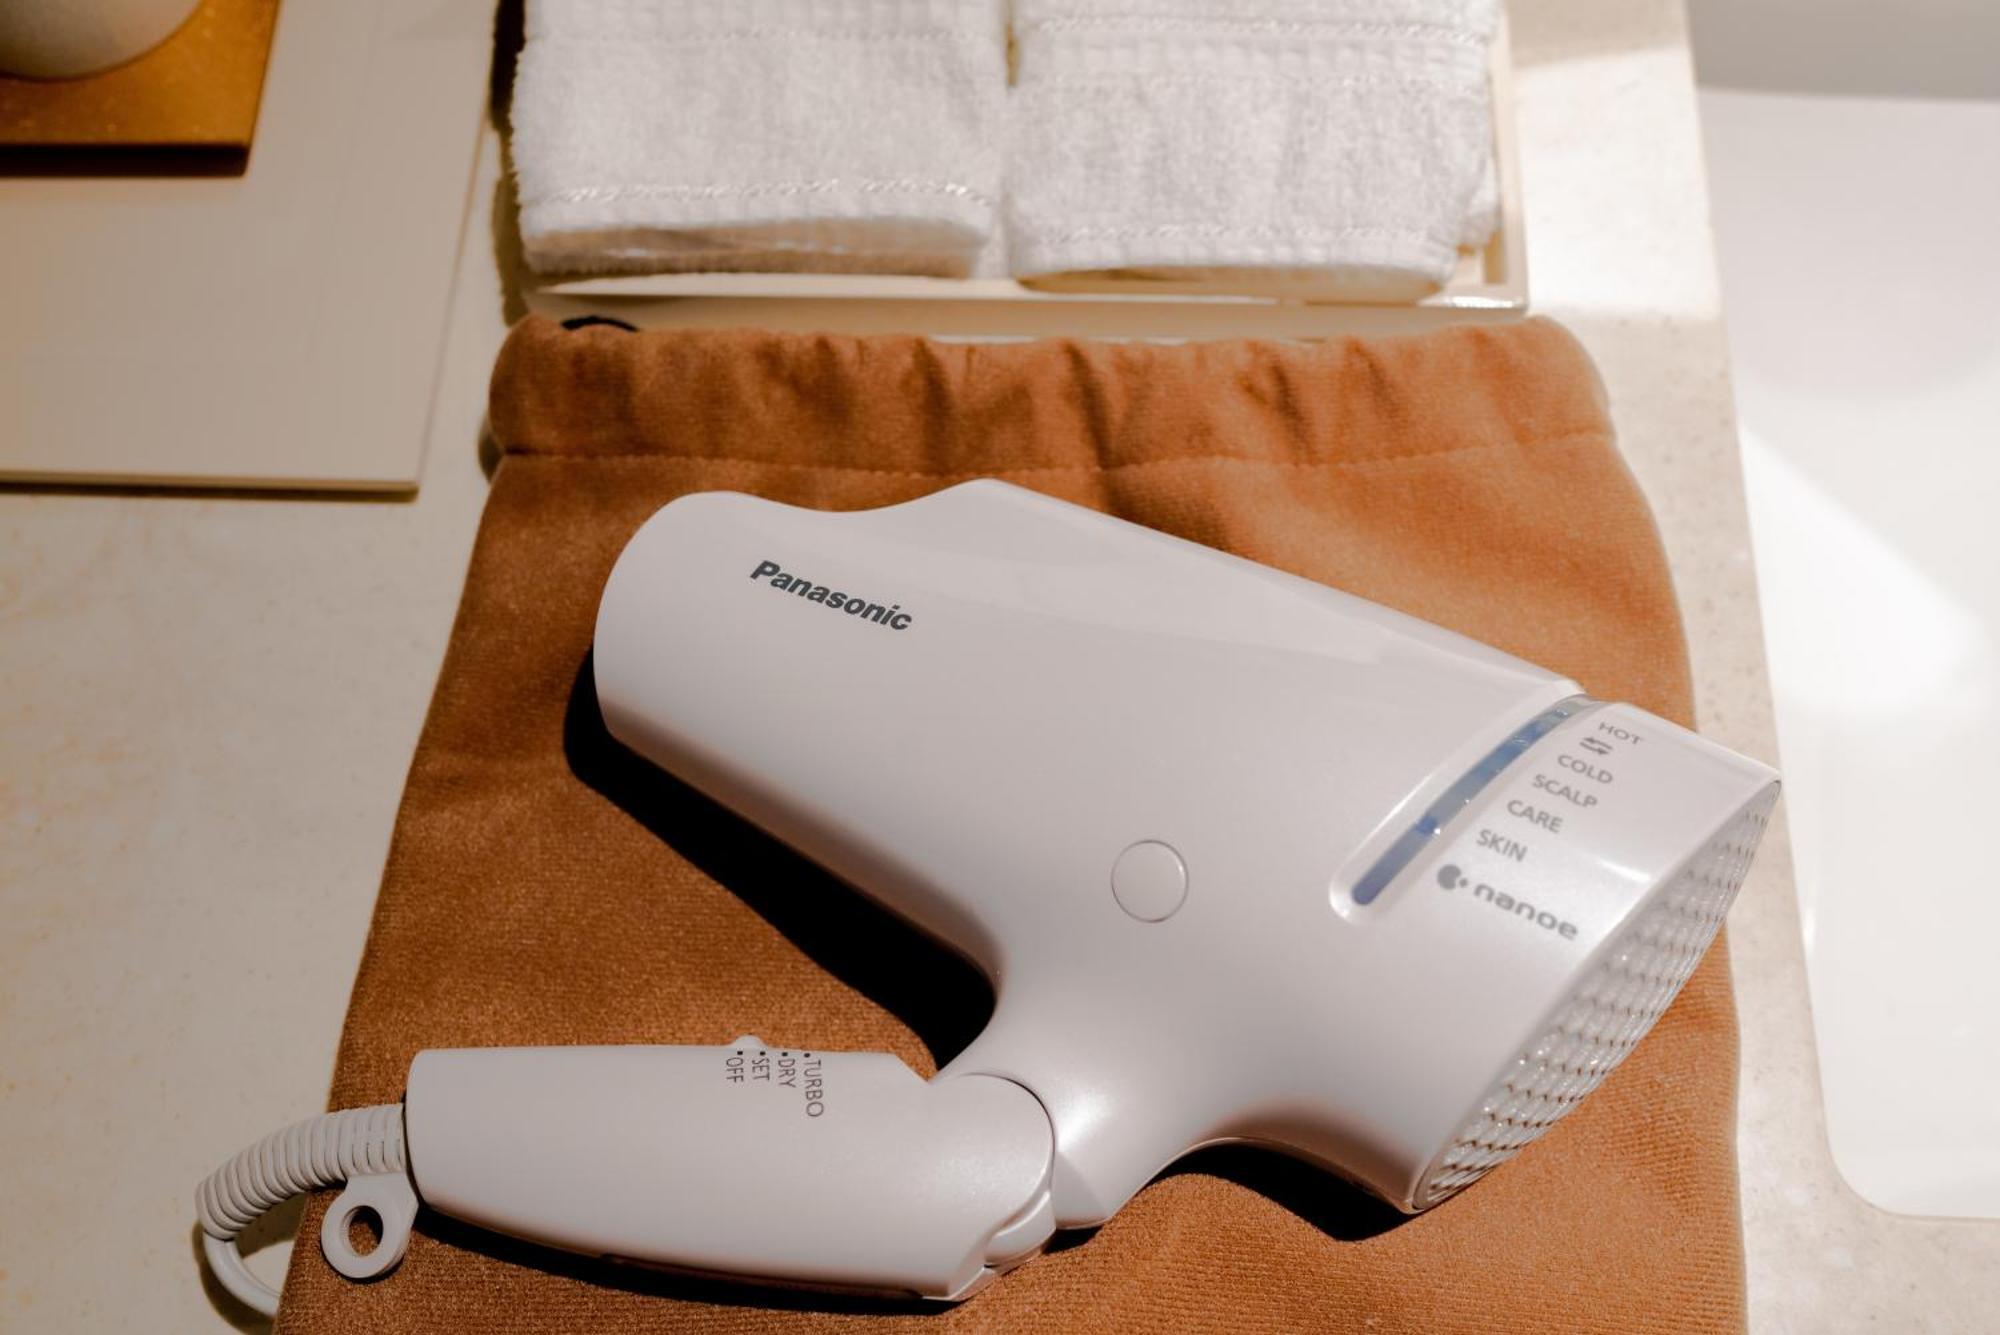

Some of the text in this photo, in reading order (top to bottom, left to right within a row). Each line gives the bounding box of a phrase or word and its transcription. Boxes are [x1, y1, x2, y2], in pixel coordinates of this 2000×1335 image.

[750, 560, 912, 630] Panasonic
[1598, 722, 1643, 745] HOT
[1557, 754, 1613, 784] COLD
[1532, 774, 1597, 808] SCALP
[1507, 799, 1563, 834] CARE
[1477, 829, 1528, 862] SKIN
[1473, 883, 1578, 940] nanoe
[726, 1057, 744, 1083] OFF
[752, 1058, 770, 1081] SET
[778, 1058, 796, 1088] DRY
[803, 1059, 824, 1117] TURBO
